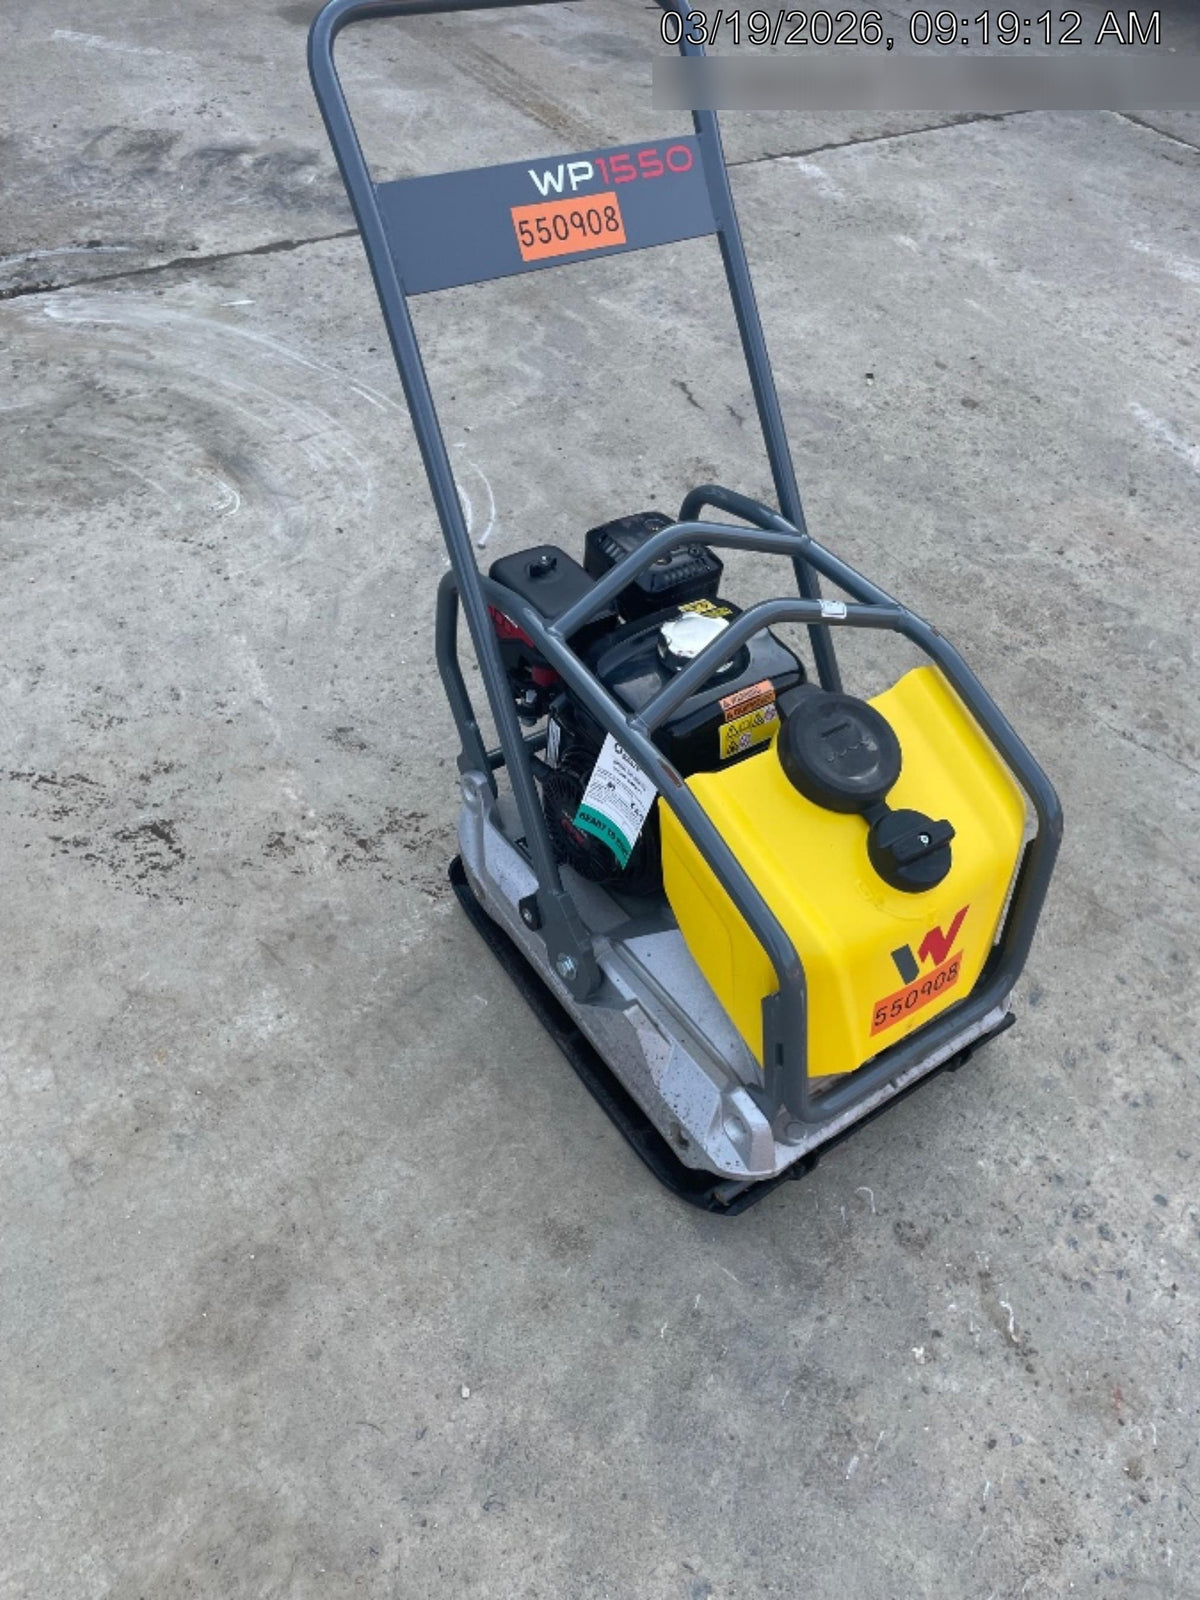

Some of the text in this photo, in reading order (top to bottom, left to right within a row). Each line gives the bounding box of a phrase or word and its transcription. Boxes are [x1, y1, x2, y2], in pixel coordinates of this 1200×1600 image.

[528, 144, 694, 196] WP1550
[518, 205, 620, 247] 550908
[873, 962, 959, 1027] 550908
